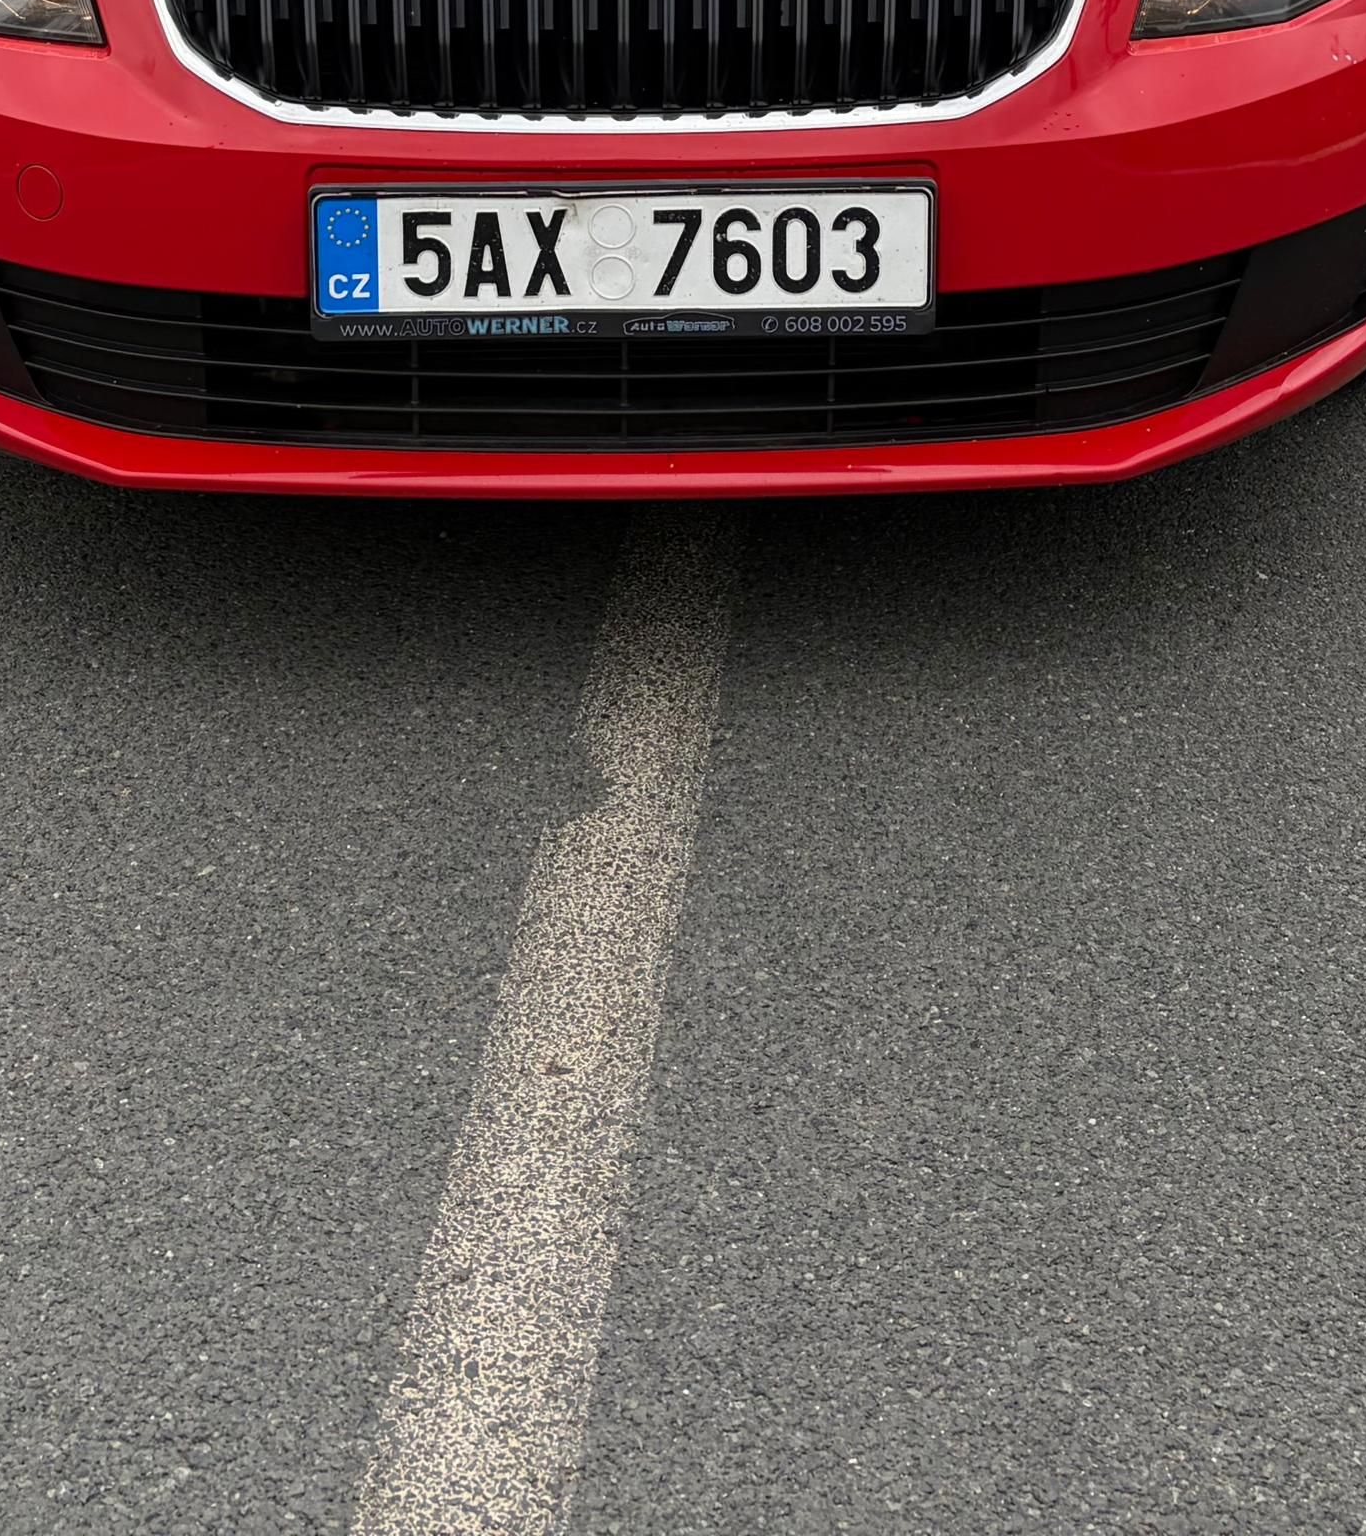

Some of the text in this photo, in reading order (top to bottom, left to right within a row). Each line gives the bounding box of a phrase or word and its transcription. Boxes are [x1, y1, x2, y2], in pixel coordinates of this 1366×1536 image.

[402, 206, 881, 297] 5AX 7603
[328, 272, 371, 299] CZ
[785, 315, 908, 332] 608 002 595
